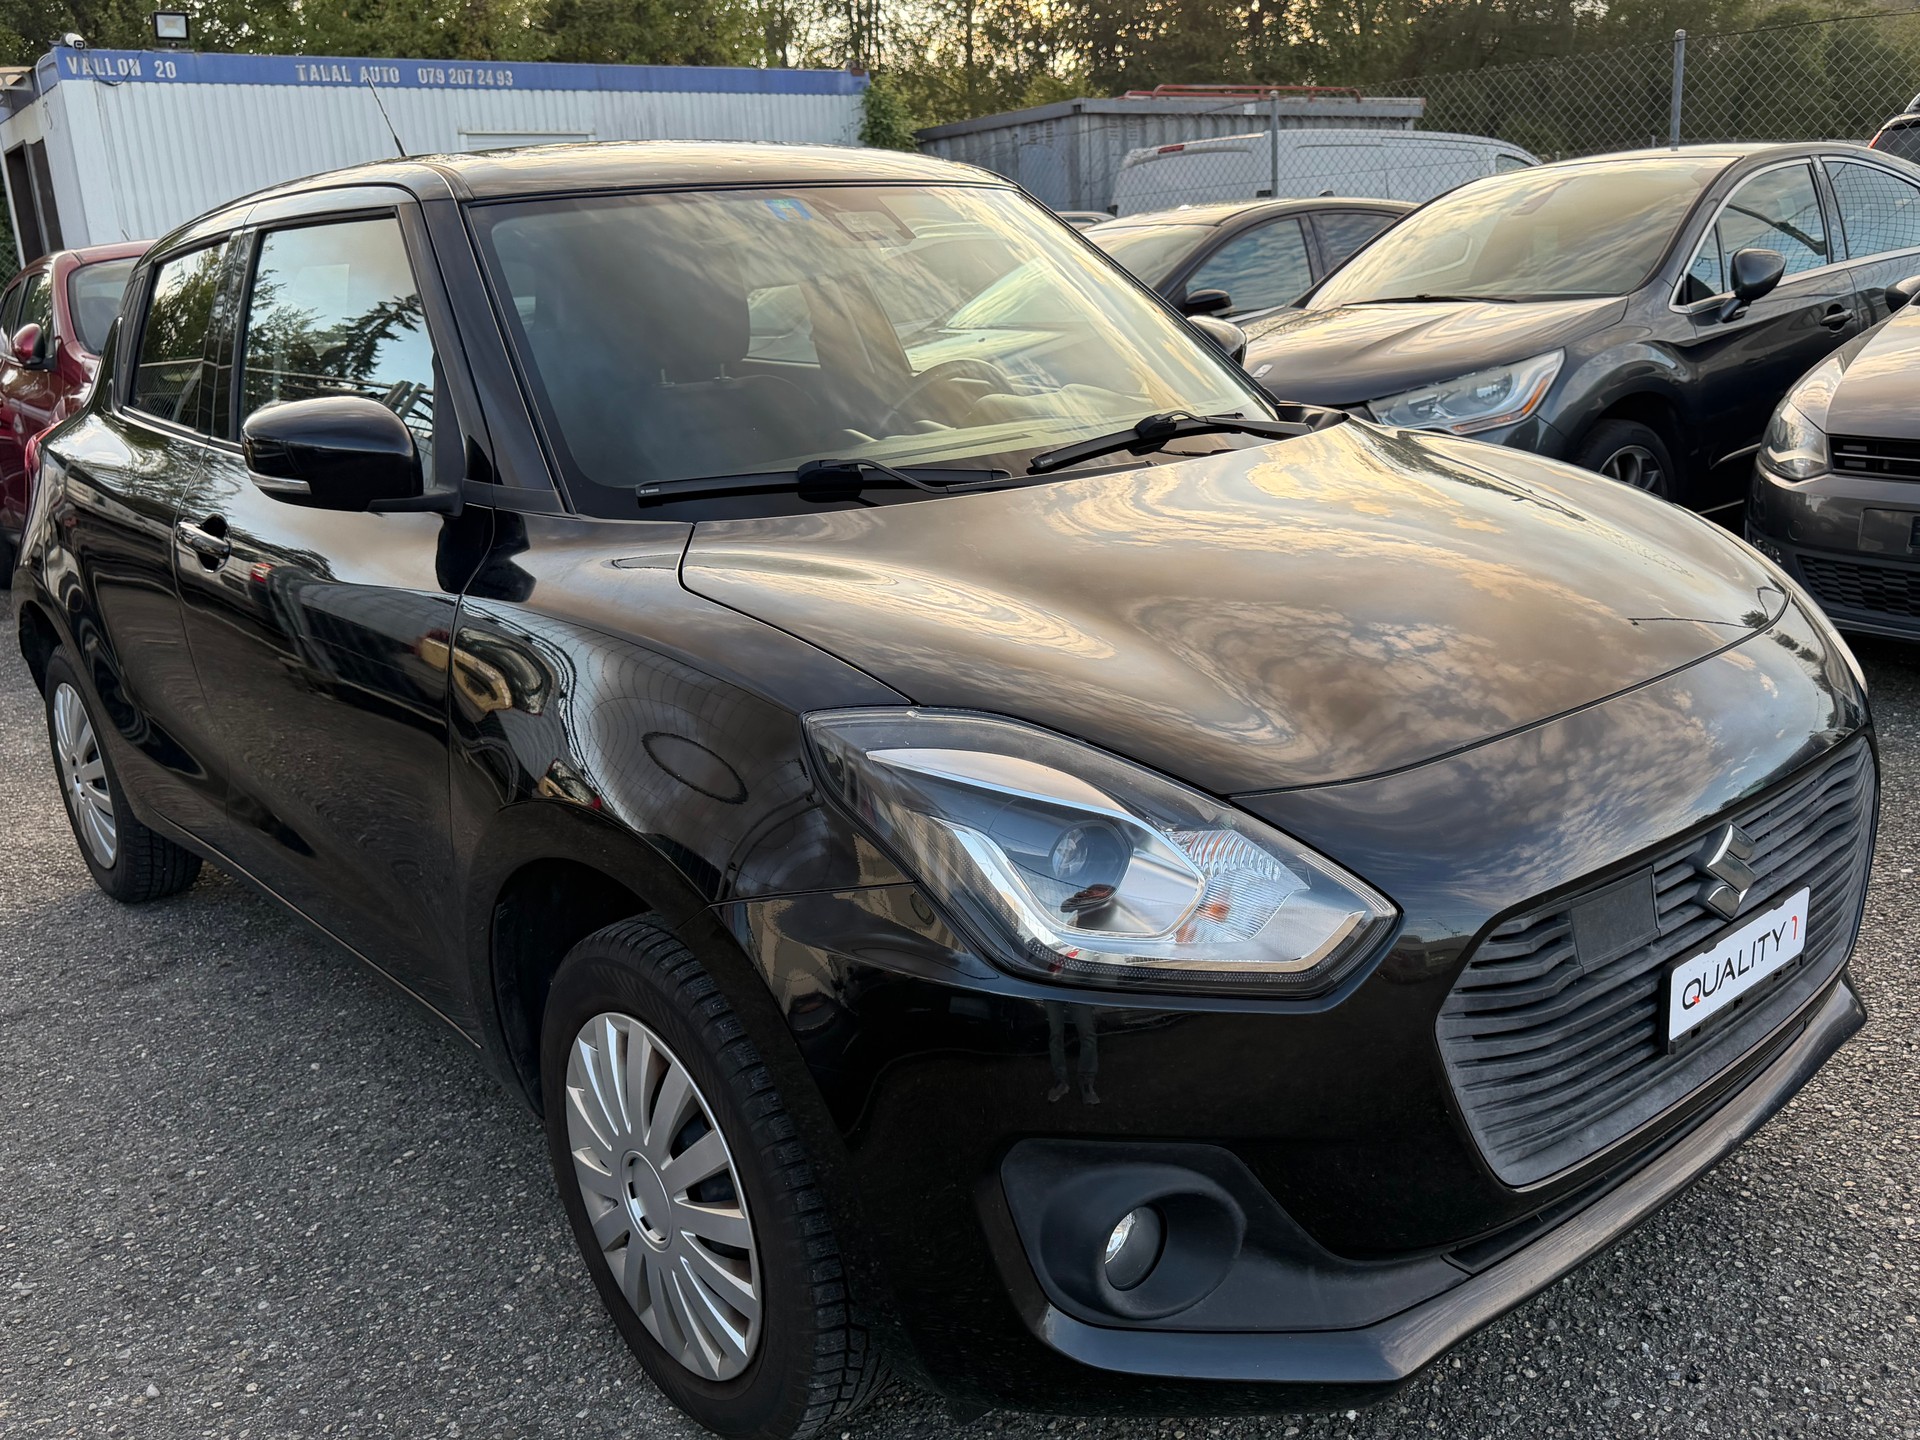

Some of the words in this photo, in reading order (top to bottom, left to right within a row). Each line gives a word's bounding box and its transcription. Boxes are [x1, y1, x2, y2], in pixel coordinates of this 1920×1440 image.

[66, 57, 142, 76] VALLON
[154, 60, 177, 79] 20
[295, 64, 352, 82] TALAL
[360, 66, 400, 83] AUTO
[417, 67, 445, 84] 079
[448, 68, 473, 85] 207
[477, 69, 494, 86] 24
[496, 70, 513, 86] 93
[1682, 921, 1787, 1010] QUALITY
[1791, 915, 1798, 940] 1
